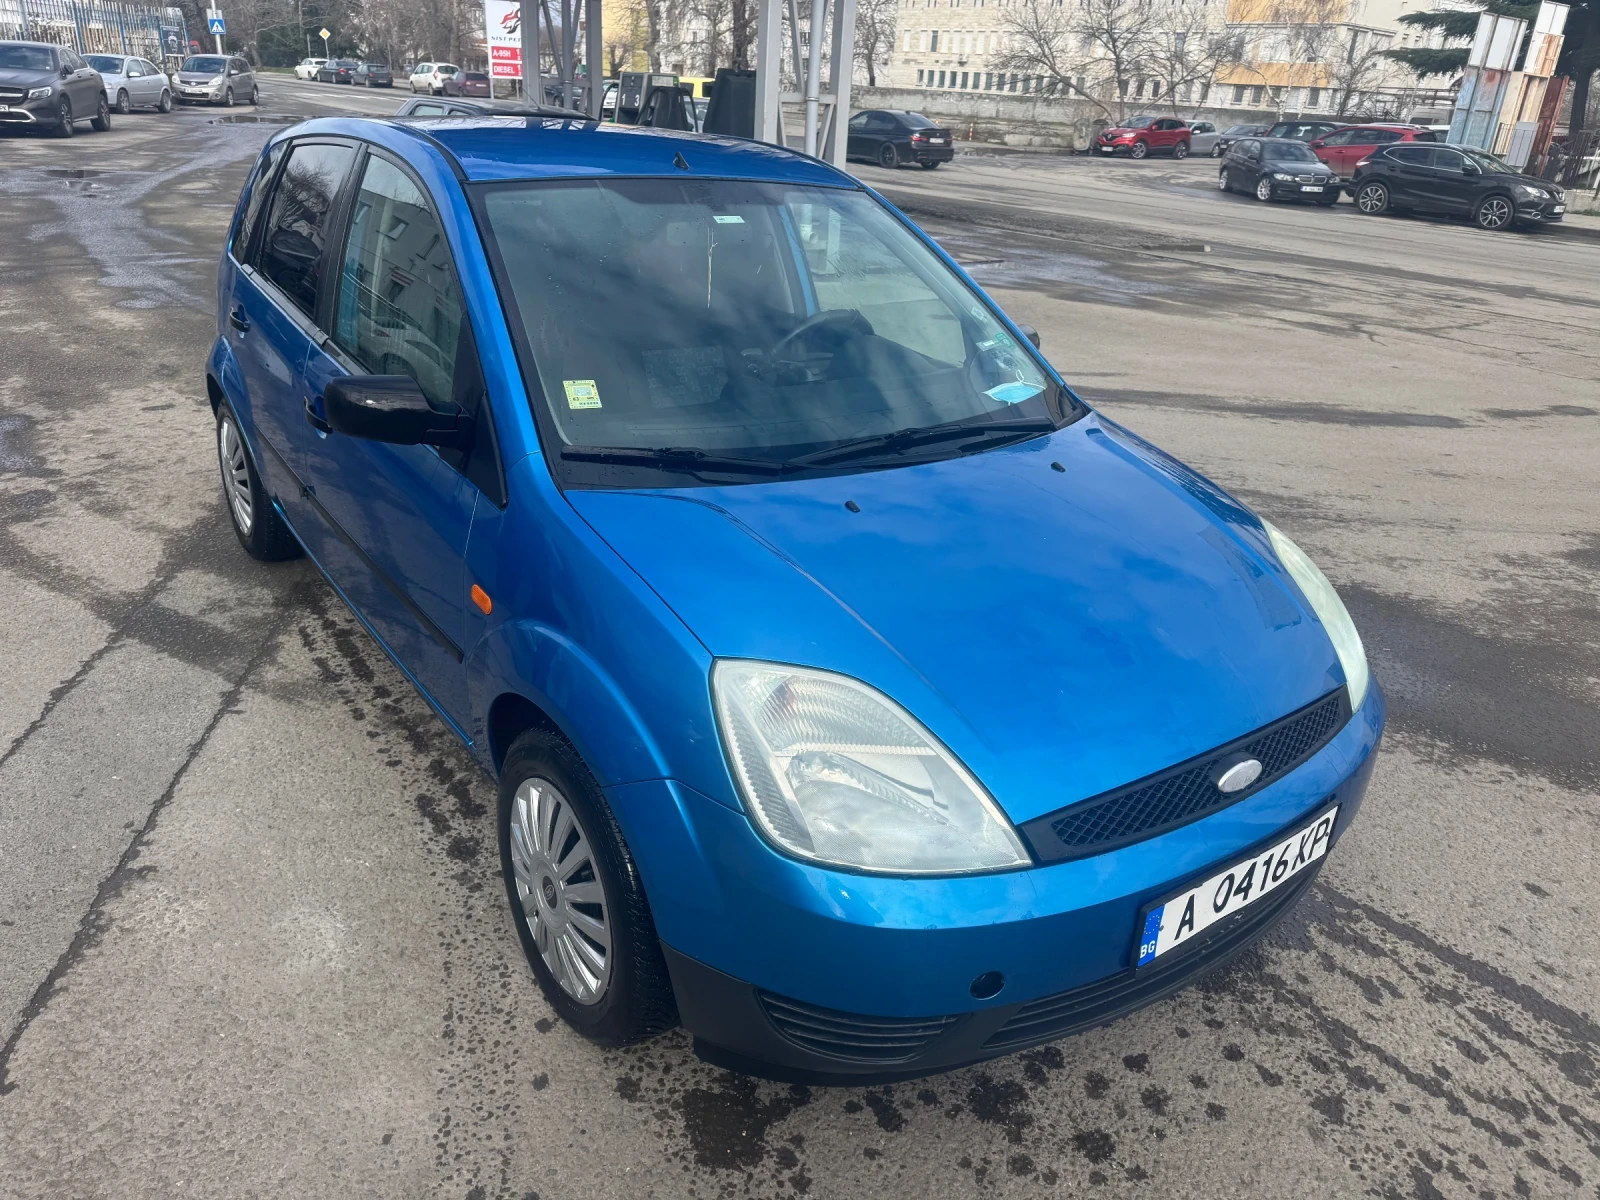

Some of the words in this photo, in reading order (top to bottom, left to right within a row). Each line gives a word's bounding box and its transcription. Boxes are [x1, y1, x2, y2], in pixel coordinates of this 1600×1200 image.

[494, 66, 515, 74] DIESEL
[621, 93, 626, 106] 1
[634, 94, 640, 107] 3
[1174, 893, 1195, 941] A
[1212, 843, 1292, 913] 0416
[1291, 816, 1331, 872] XP
[1139, 940, 1156, 959] BG
